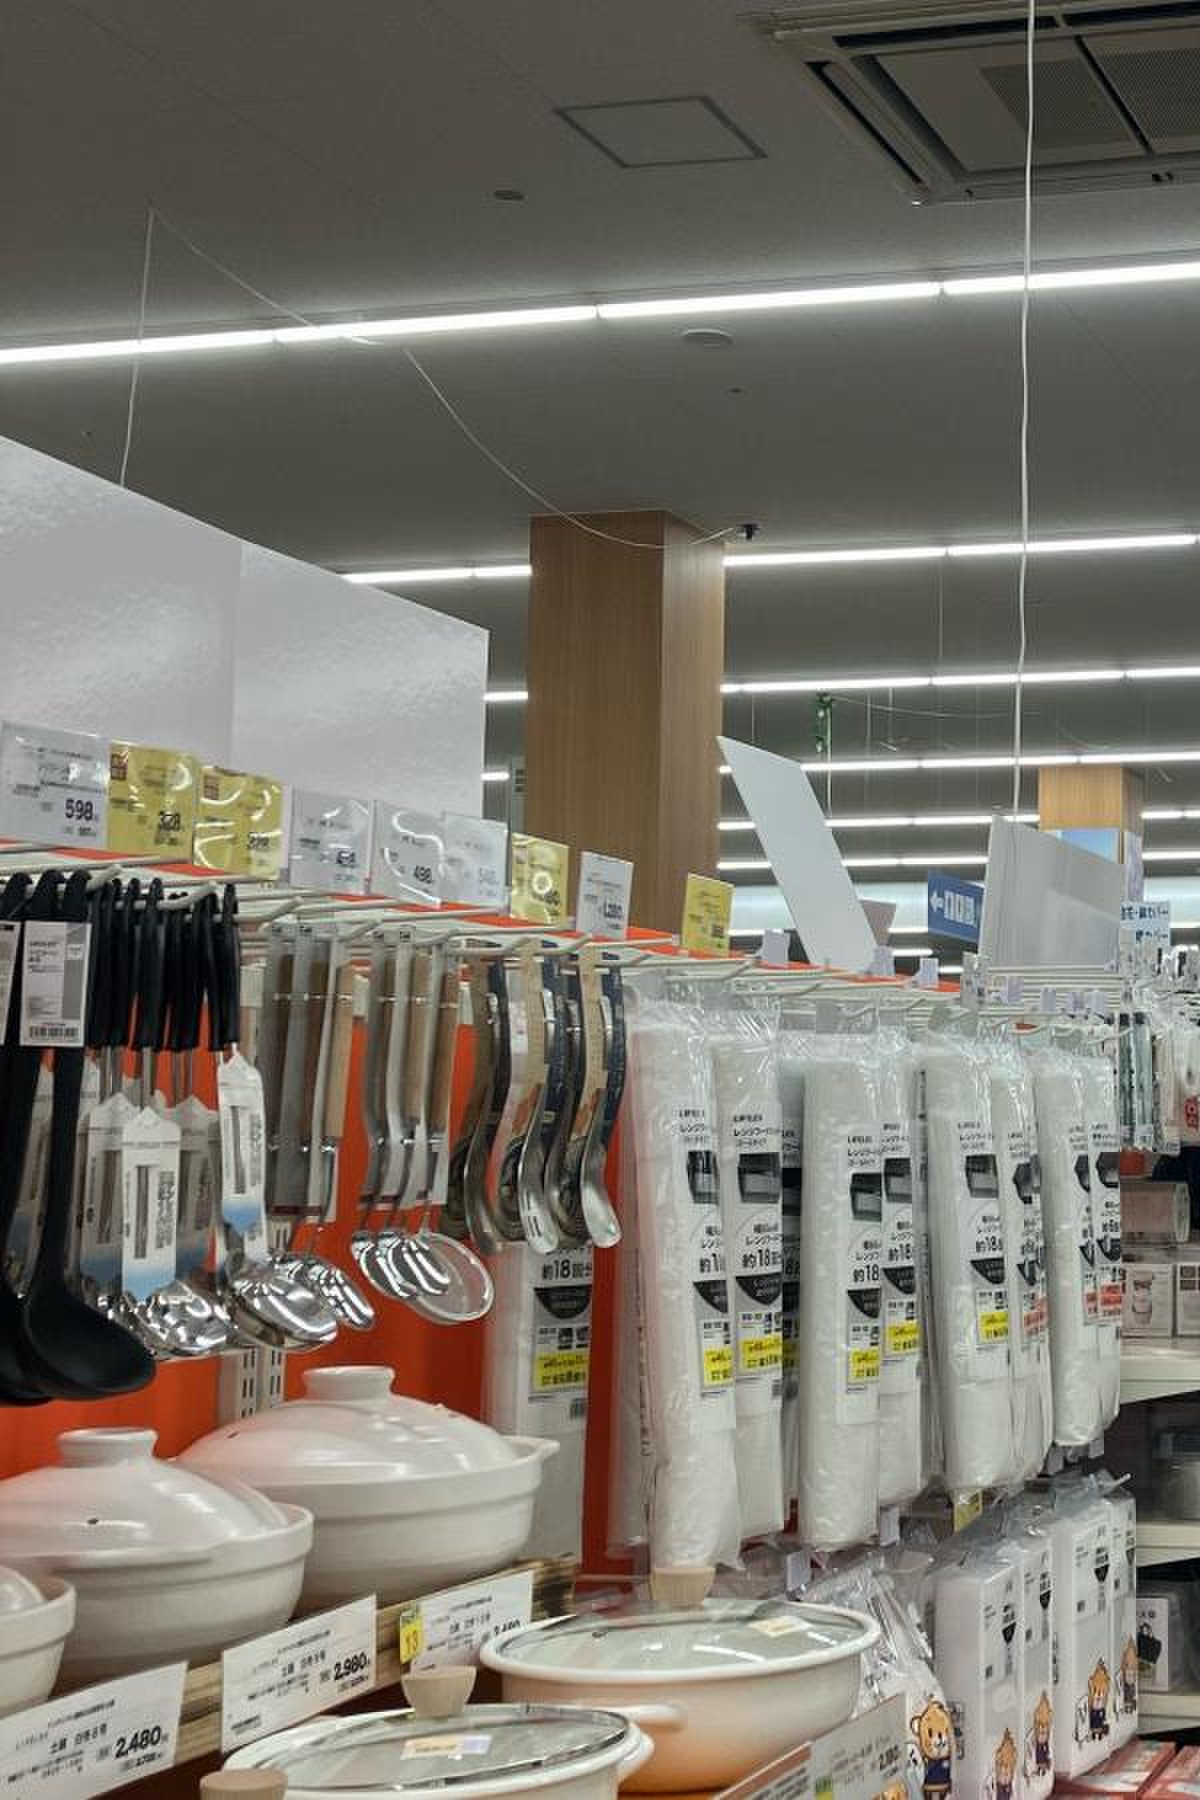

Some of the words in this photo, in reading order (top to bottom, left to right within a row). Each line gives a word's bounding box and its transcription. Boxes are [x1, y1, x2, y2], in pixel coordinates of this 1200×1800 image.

[65, 799, 93, 820] 598
[333, 1651, 367, 1681] 2,980
[114, 1725, 161, 1759] 2,480
